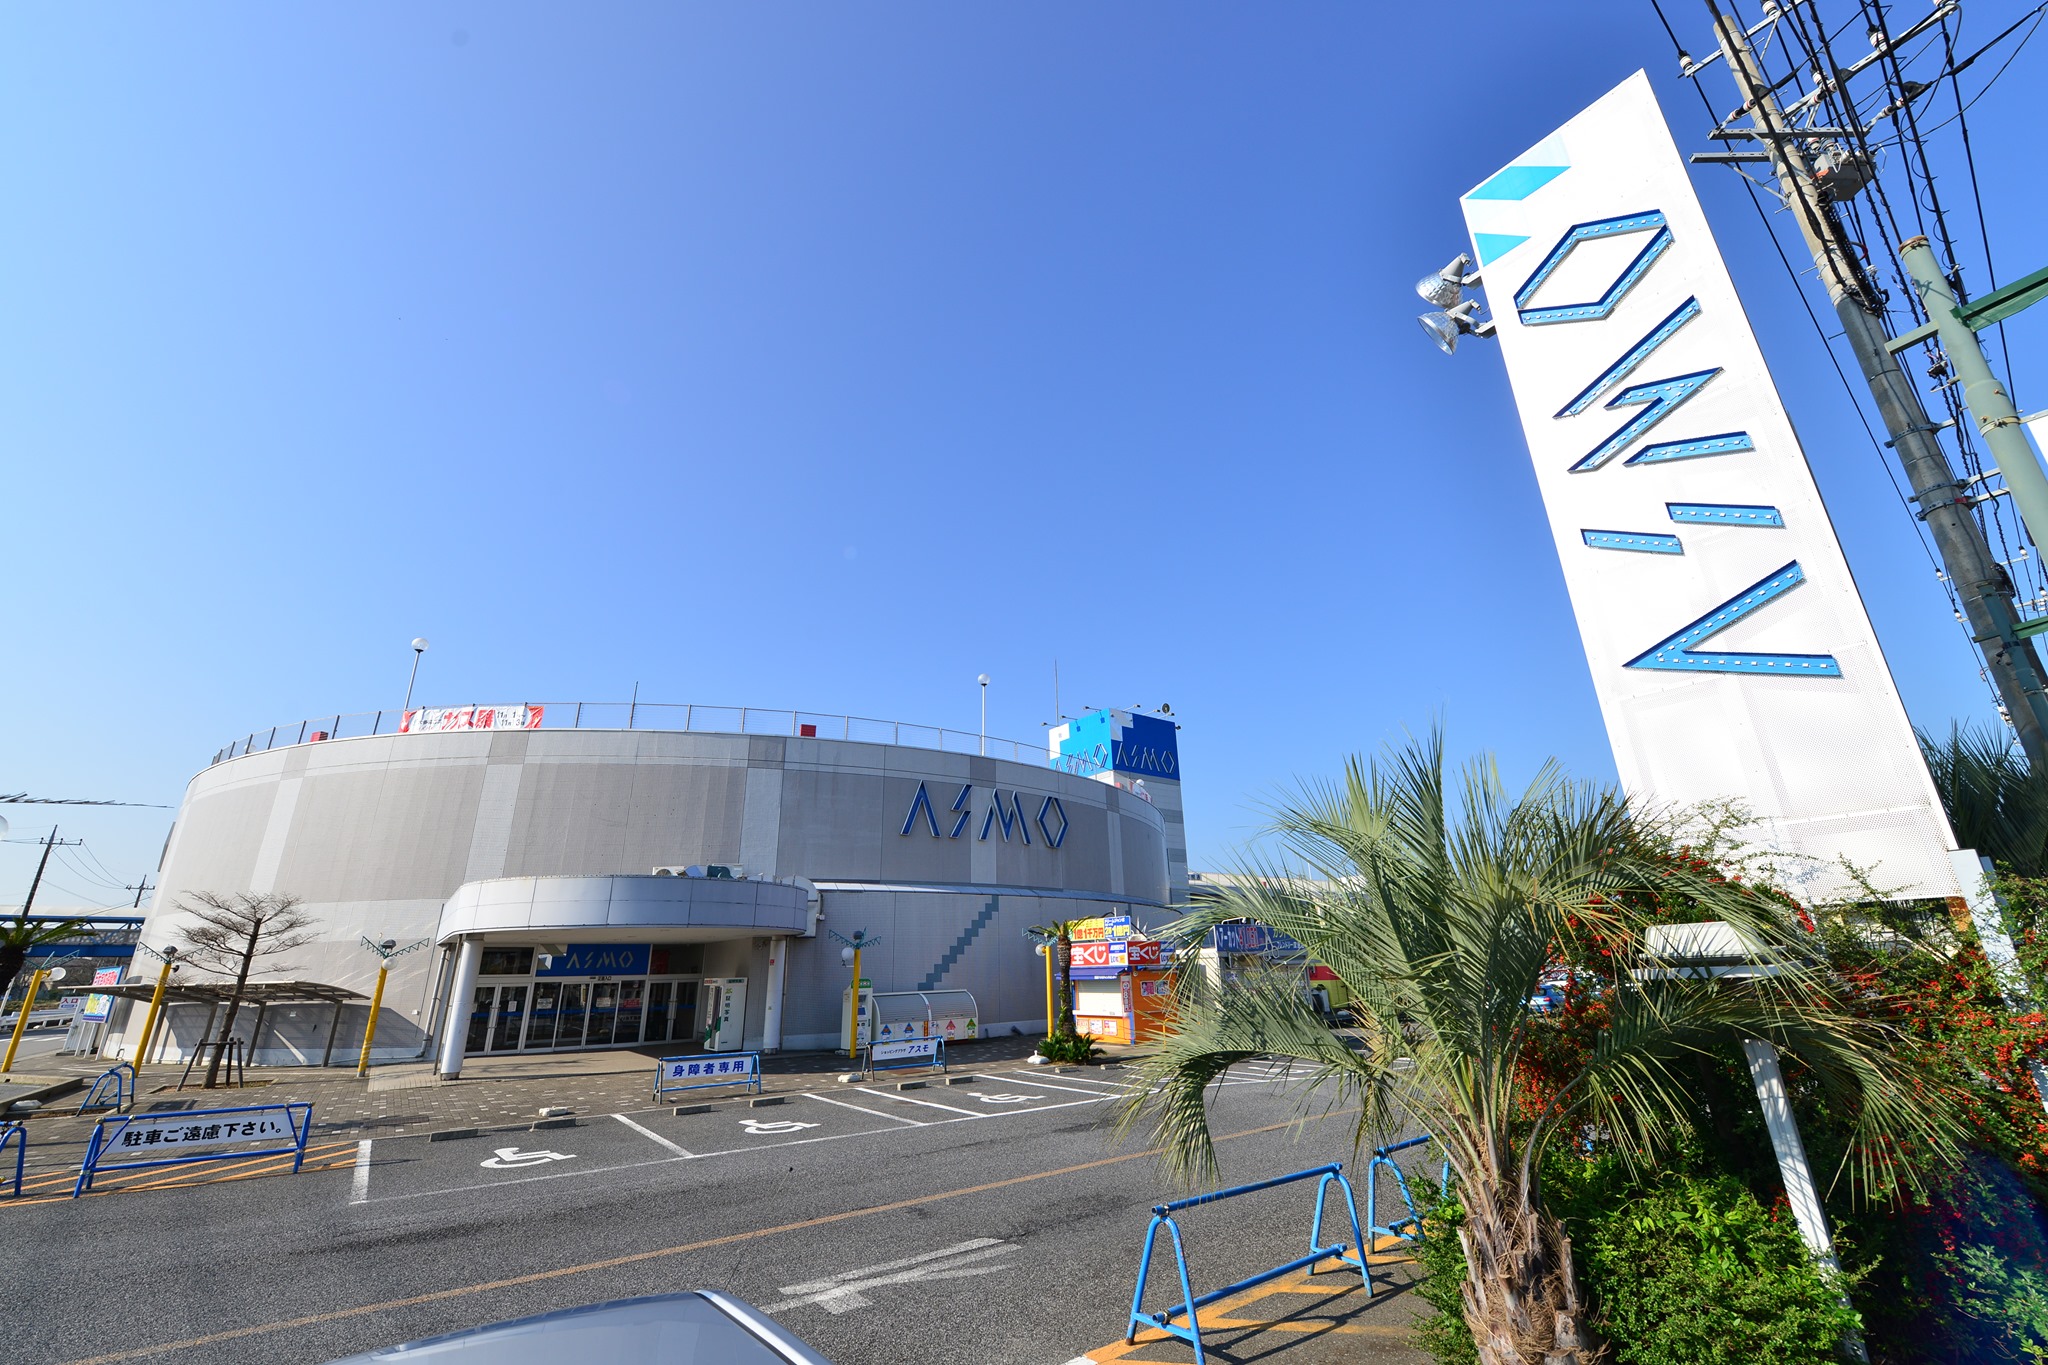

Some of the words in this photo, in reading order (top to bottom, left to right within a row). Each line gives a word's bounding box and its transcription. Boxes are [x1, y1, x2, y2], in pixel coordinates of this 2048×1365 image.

[1513, 209, 1841, 678] ASMO
[1055, 743, 1108, 775] ASMO
[1116, 742, 1175, 774] ASMO
[900, 779, 1069, 849] ASMO
[566, 951, 634, 969] ASMO
[1071, 945, 1106, 964] 宝くじ
[1129, 945, 1160, 961] 宝くじ
[908, 1044, 929, 1054] アスモ
[672, 1060, 744, 1078] 身障者専用
[121, 1121, 282, 1148] 駐車ご遠慮下さい。
